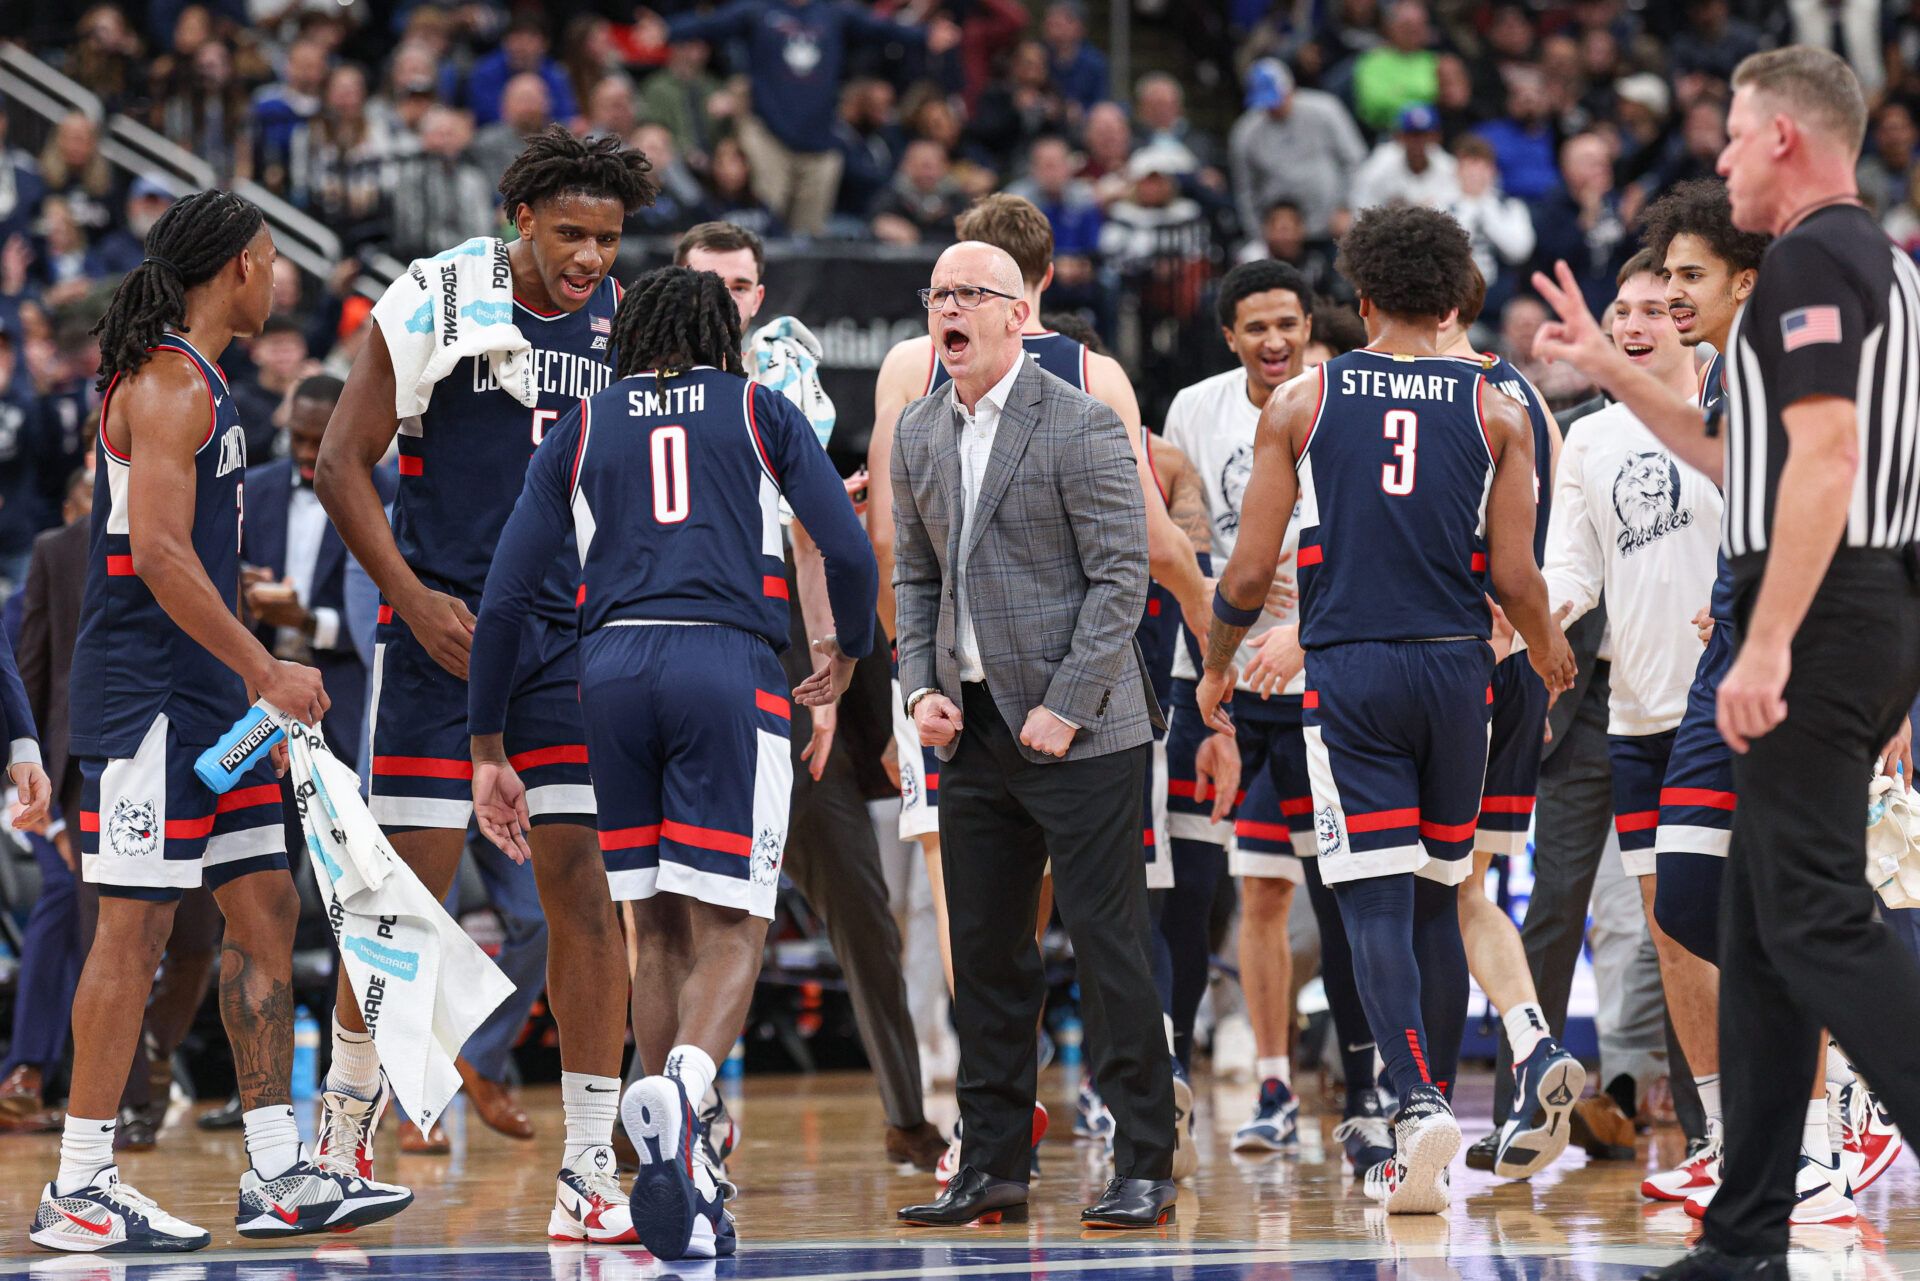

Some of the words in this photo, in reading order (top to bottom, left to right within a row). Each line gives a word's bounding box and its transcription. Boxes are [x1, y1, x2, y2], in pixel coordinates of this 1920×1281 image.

[473, 348, 613, 401] CECTICUT
[628, 383, 705, 417] SMITH
[1342, 369, 1459, 403] STEWART
[650, 425, 690, 525] 0
[1381, 407, 1418, 496] 3
[1617, 508, 1694, 559] Huskies
[360, 943, 414, 971] POWERADE
